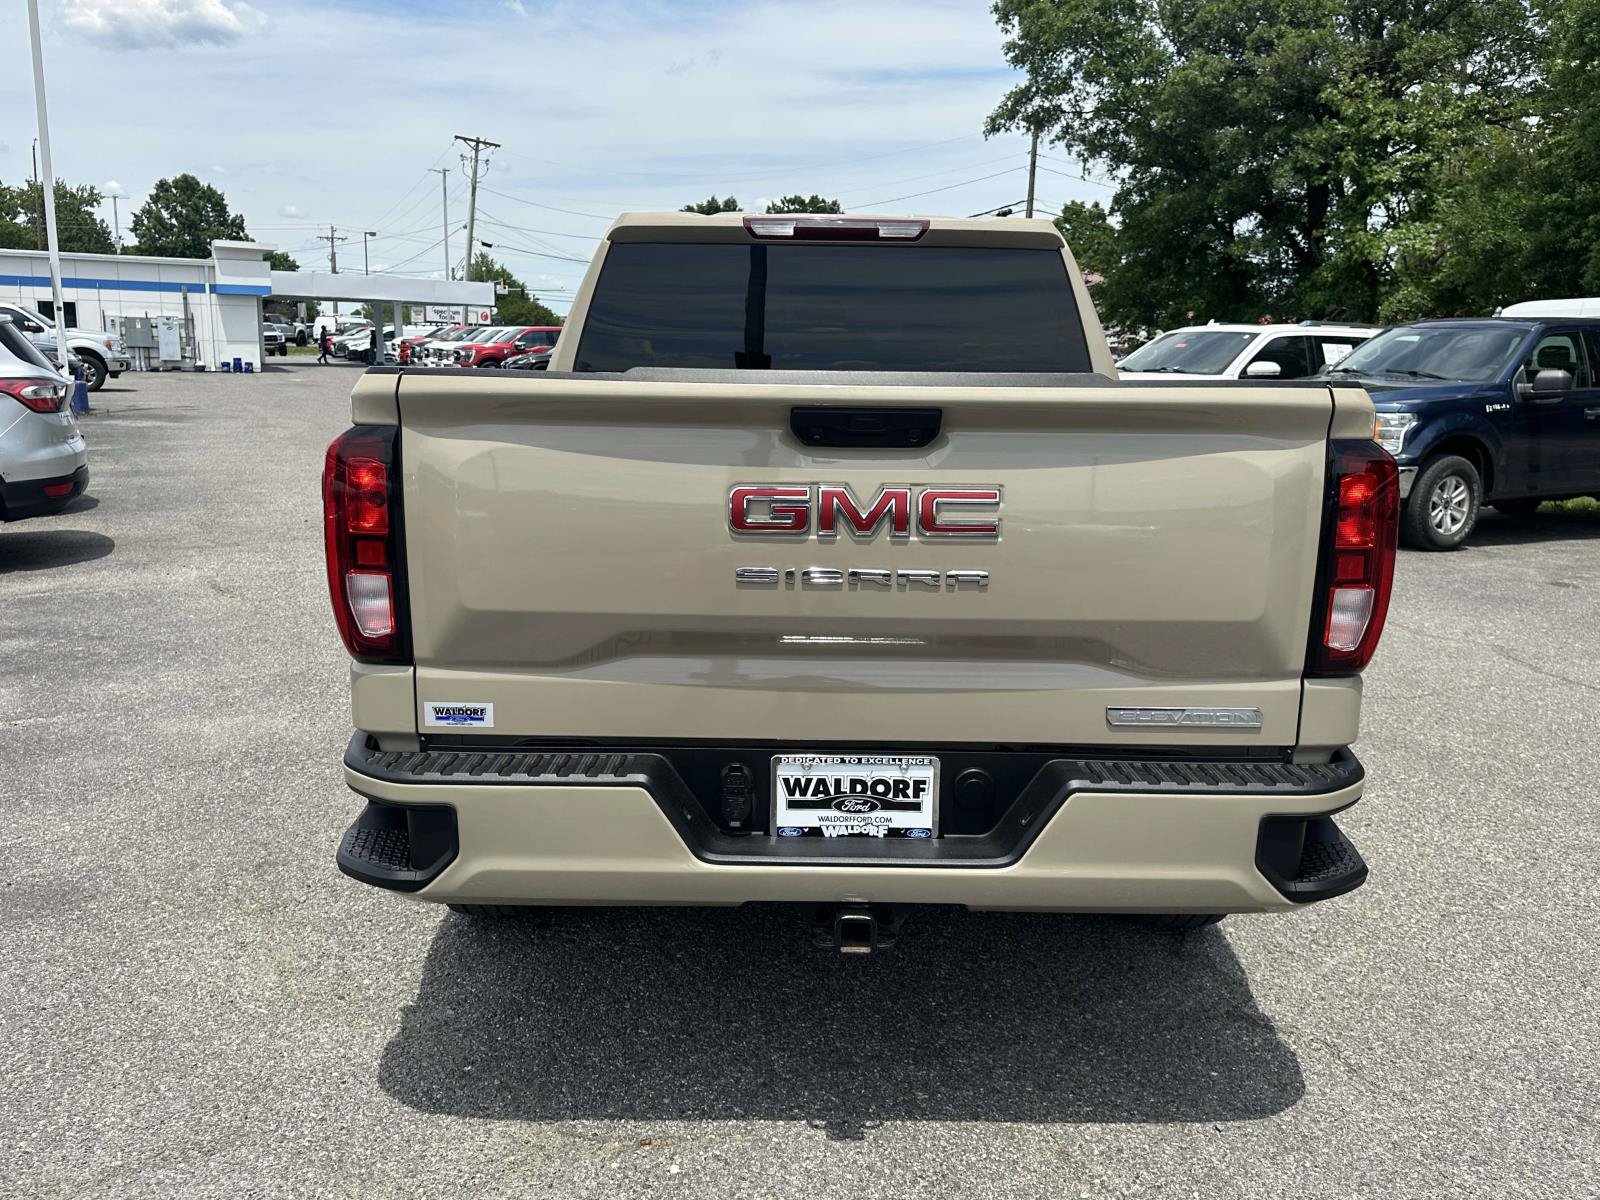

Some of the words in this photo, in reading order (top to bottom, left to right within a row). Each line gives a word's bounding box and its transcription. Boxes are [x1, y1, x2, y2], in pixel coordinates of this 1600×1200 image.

[728, 485, 1001, 539] GMC
[735, 567, 990, 586] SIERRA
[433, 707, 486, 716] WALDORF
[1119, 710, 1251, 723] ELEVATION
[781, 756, 841, 764] DEDICATED
[861, 757, 931, 765] EXCELLENCE
[781, 776, 928, 799] WALDORF
[841, 799, 871, 812] Ford
[817, 815, 893, 824] WALDORFFORD.COM
[820, 825, 889, 838] WALDORF
